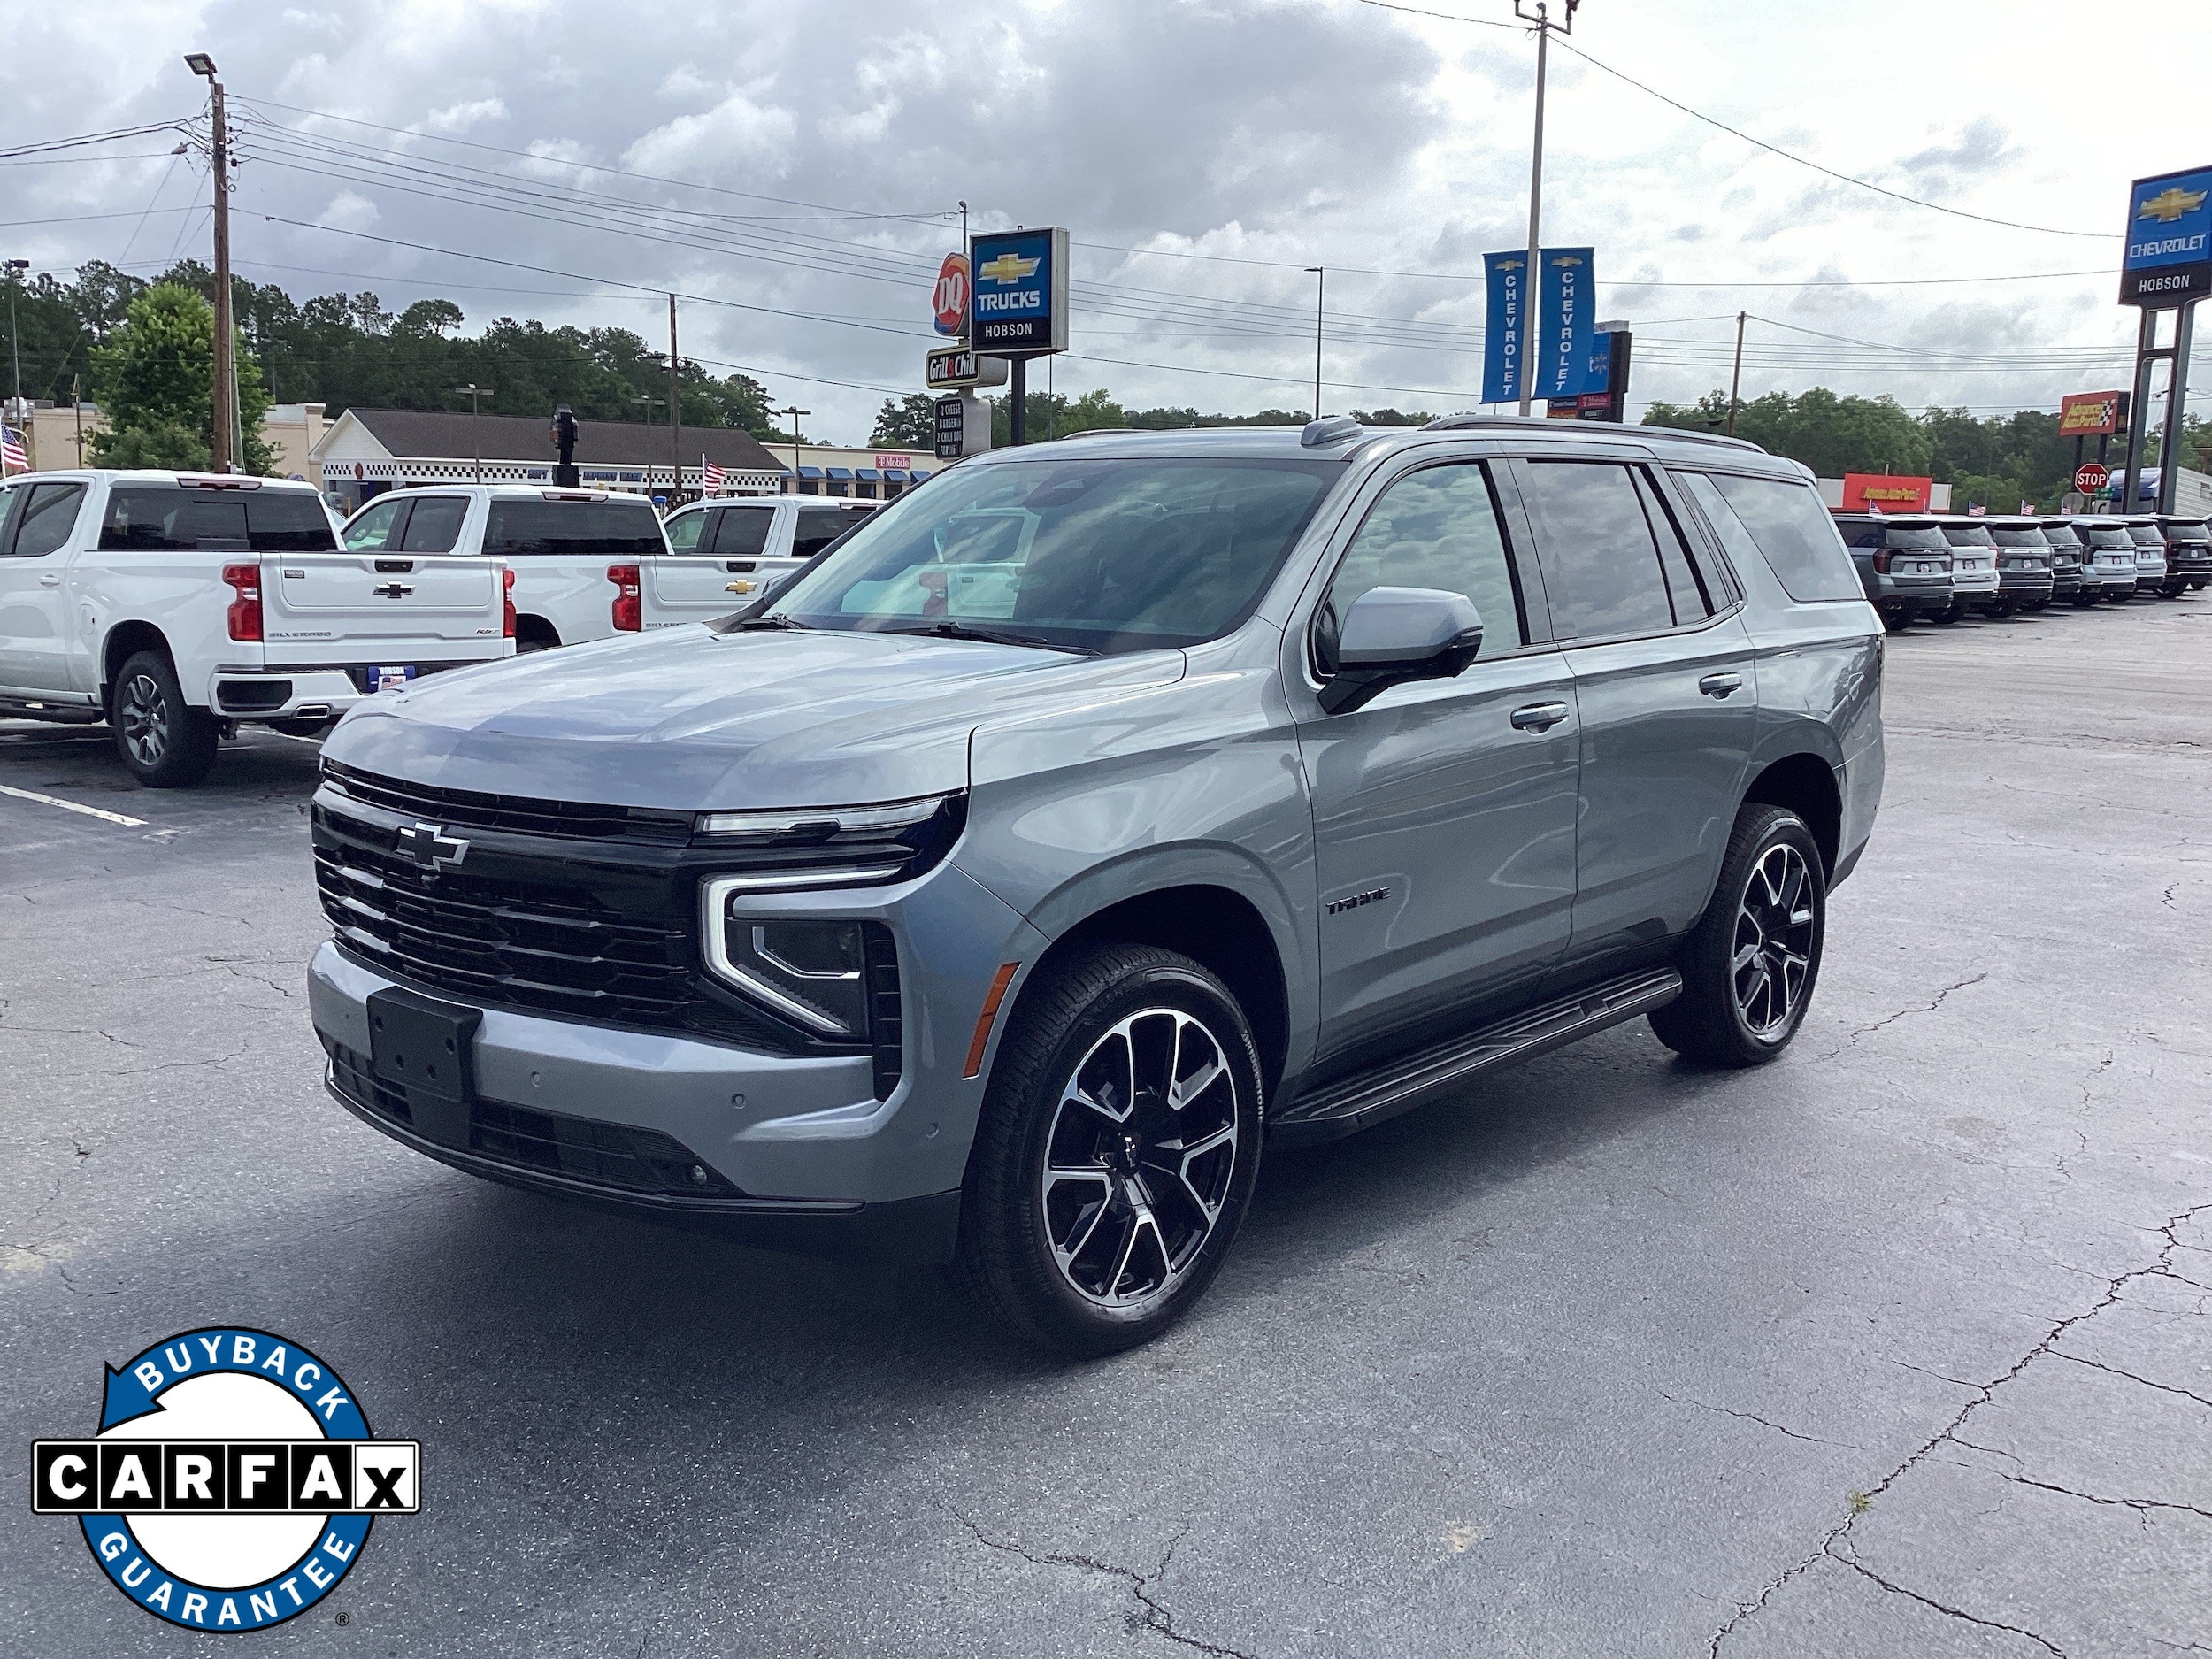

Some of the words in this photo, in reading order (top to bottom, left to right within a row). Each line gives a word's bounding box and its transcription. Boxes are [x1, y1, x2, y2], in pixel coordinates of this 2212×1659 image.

[2130, 234, 2206, 258] CHEVROLET
[939, 272, 963, 315] DQ
[2139, 275, 2190, 293] HOBSON
[978, 290, 1040, 311] TRUCKS
[986, 323, 1032, 337] HOBSON
[1502, 275, 1517, 395] CHEVROLET
[1555, 272, 1574, 391] CHEVROLET
[930, 357, 949, 380] Grill
[955, 352, 976, 377] Chill
[2078, 473, 2106, 486] STOP
